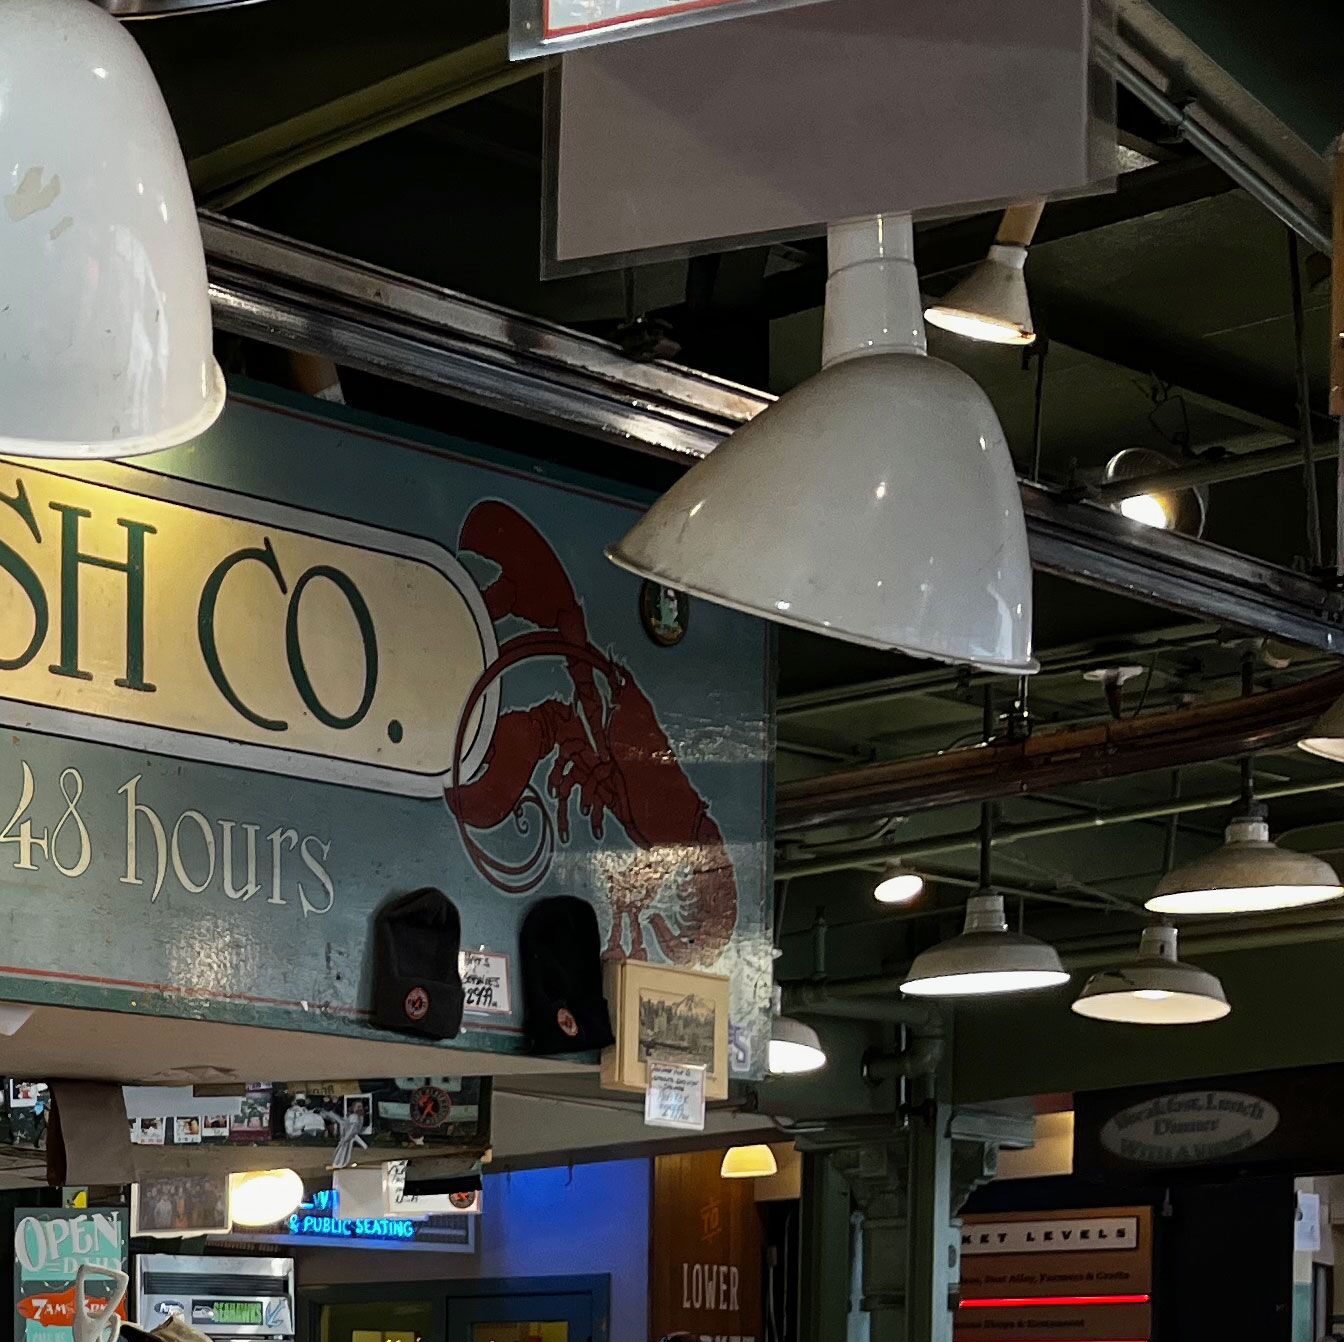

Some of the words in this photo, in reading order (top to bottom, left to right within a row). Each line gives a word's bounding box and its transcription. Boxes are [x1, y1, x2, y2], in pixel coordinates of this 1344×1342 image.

[196, 533, 405, 745] CO.
[116, 773, 337, 917] hours
[15, 1211, 121, 1272] OPEN
[303, 1215, 352, 1236] PUBLIC
[355, 1217, 414, 1239] SEATING
[1026, 1227, 1127, 1242] LEVELS
[682, 1262, 740, 1311] LOWER
